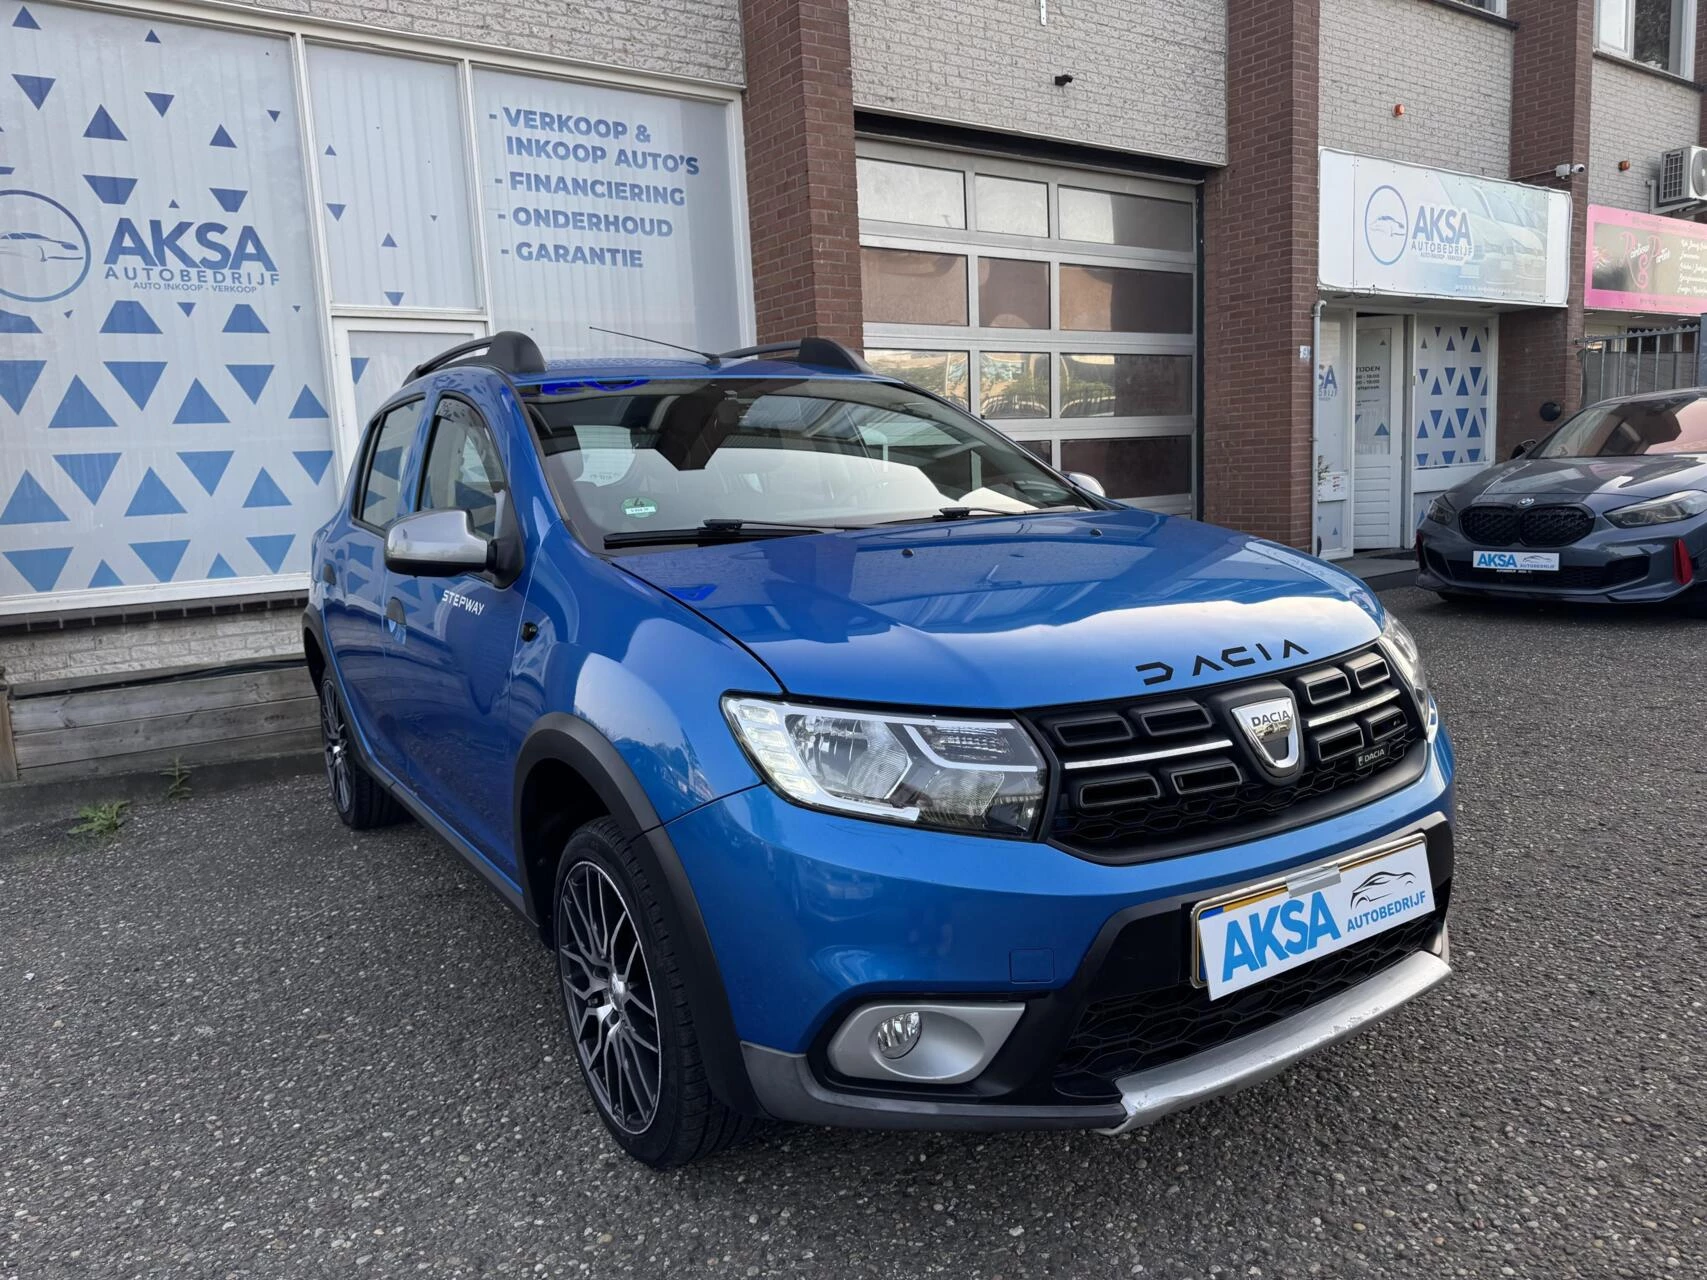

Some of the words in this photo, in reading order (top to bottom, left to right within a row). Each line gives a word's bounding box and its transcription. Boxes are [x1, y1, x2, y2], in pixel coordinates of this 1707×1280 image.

[502, 107, 628, 140] VERKOOP
[635, 124, 651, 143] &
[506, 136, 607, 164] INKOOP
[614, 149, 700, 176] AUTO'S
[509, 171, 686, 206] FINANCIERING
[512, 207, 673, 237] ONDERHOUD
[1412, 205, 1472, 246] AKSA
[104, 218, 278, 272] AKSA
[515, 242, 644, 268] GARANTIE
[1411, 241, 1473, 257] AUTOBEDRIJF
[104, 266, 280, 285] AUTOBEDRIJF
[133, 282, 162, 291] AUTO
[163, 283, 203, 292] INKOOP
[212, 285, 257, 294] VERKOOP
[1477, 553, 1517, 568] AKSA
[441, 590, 485, 616] STEPWAY
[1136, 639, 1309, 686] DACIA
[1251, 709, 1292, 727] DACIA
[1364, 748, 1385, 762] DACIA
[1222, 891, 1341, 983] AKSA
[1347, 890, 1426, 933] AUTOBEDRIJF
